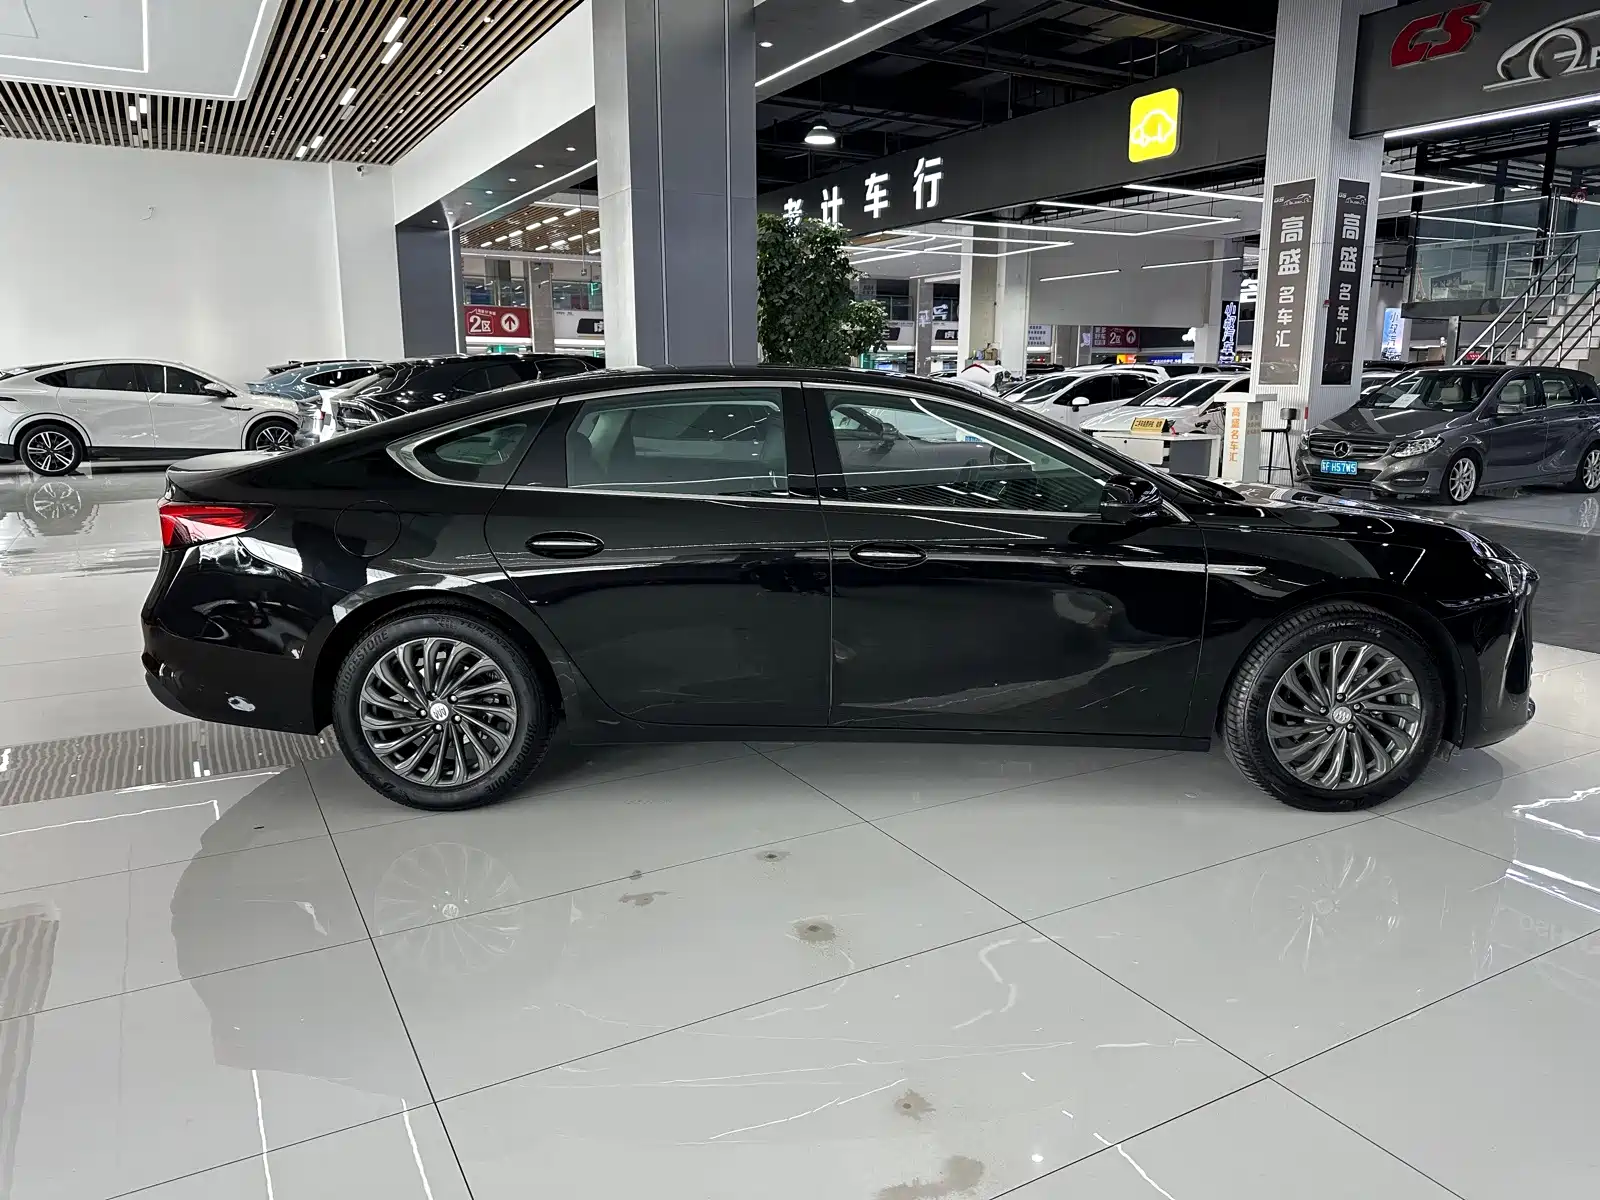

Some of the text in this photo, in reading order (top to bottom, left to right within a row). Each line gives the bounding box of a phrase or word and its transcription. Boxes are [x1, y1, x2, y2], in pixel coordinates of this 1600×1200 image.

[469, 315, 491, 333] 2区
[1228, 406, 1241, 463] 高盛名车汇
[485, 721, 539, 796] BRIDGESTONE
